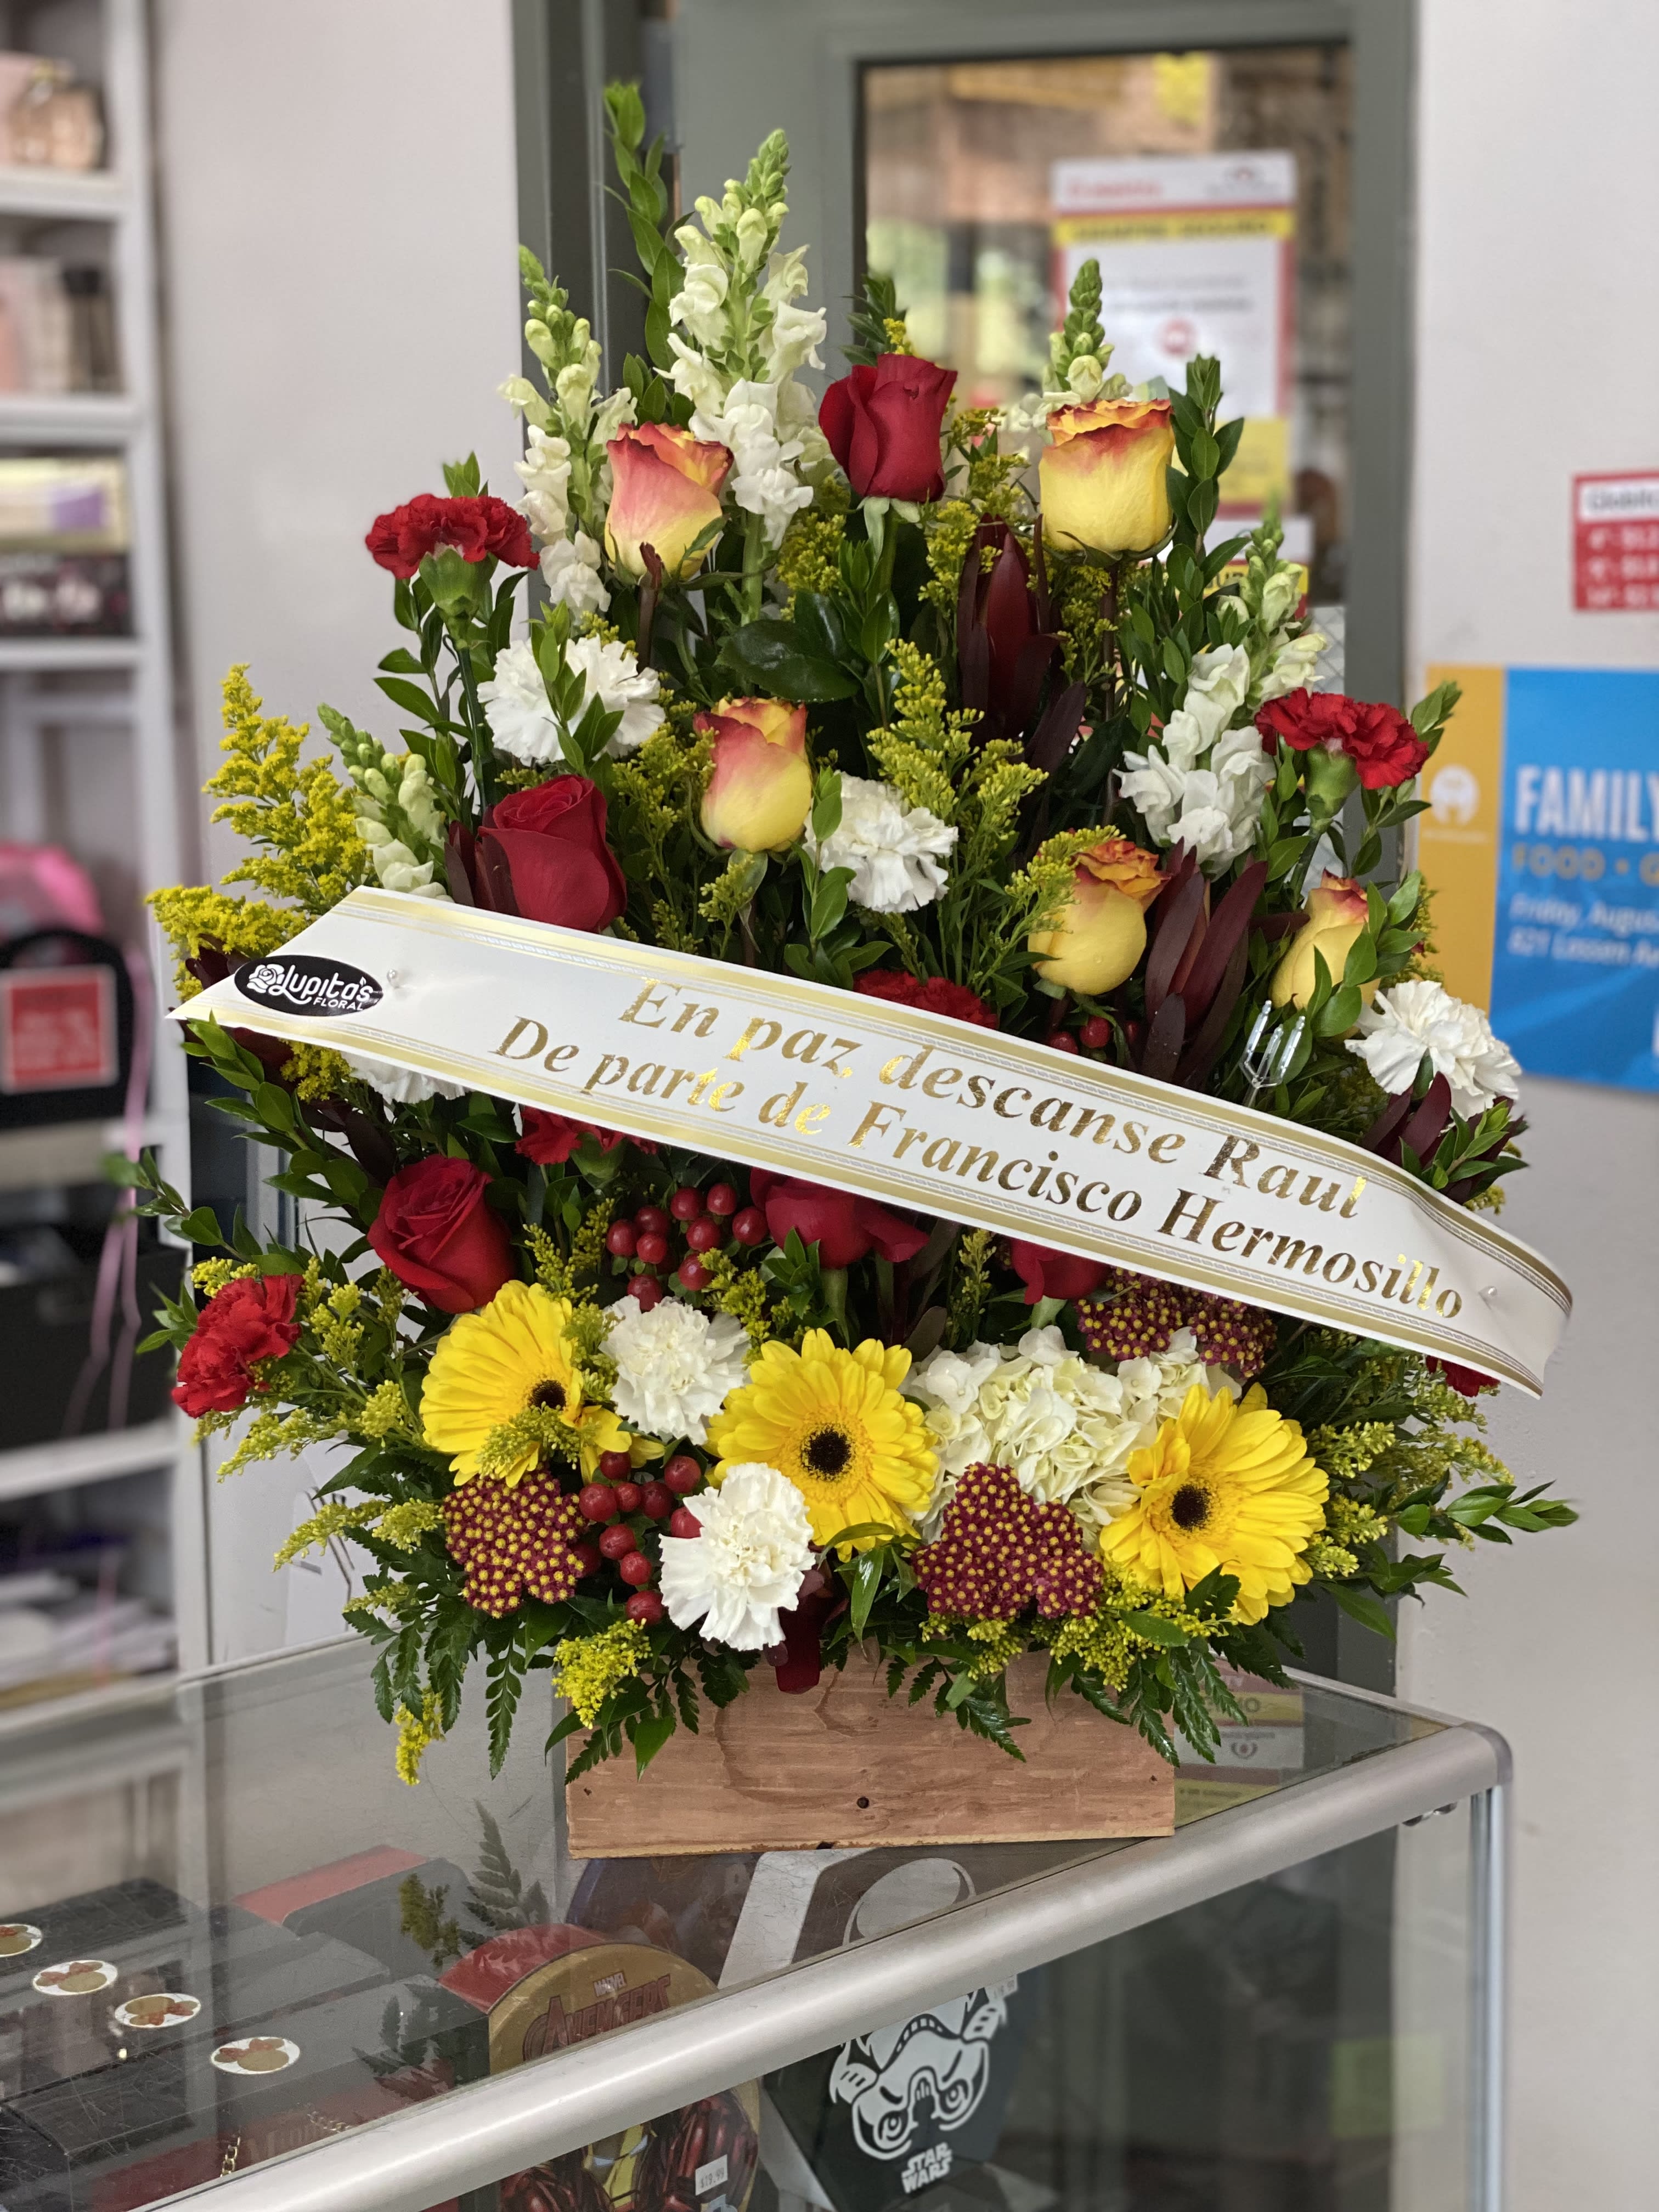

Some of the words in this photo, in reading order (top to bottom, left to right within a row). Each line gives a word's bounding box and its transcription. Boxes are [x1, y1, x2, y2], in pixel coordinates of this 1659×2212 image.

[1514, 766, 1659, 843] FAMILY
[268, 964, 374, 1005] Lupita's
[313, 997, 364, 1011] FLORAL
[619, 978, 723, 1038] En
[723, 1016, 866, 1080] paz
[879, 1043, 1186, 1164] descanse
[1204, 1133, 1367, 1219] Raul
[488, 1015, 580, 1072] De
[579, 1052, 746, 1113] parte
[758, 1082, 832, 1136] de
[847, 1099, 1143, 1222] Francisco
[1156, 1188, 1464, 1319] Hermosillo
[595, 1972, 624, 1996] MARVEL
[528, 1974, 671, 2058] AVENGERS
[901, 2142, 952, 2176] STAR
[902, 2154, 952, 2193] WARS
